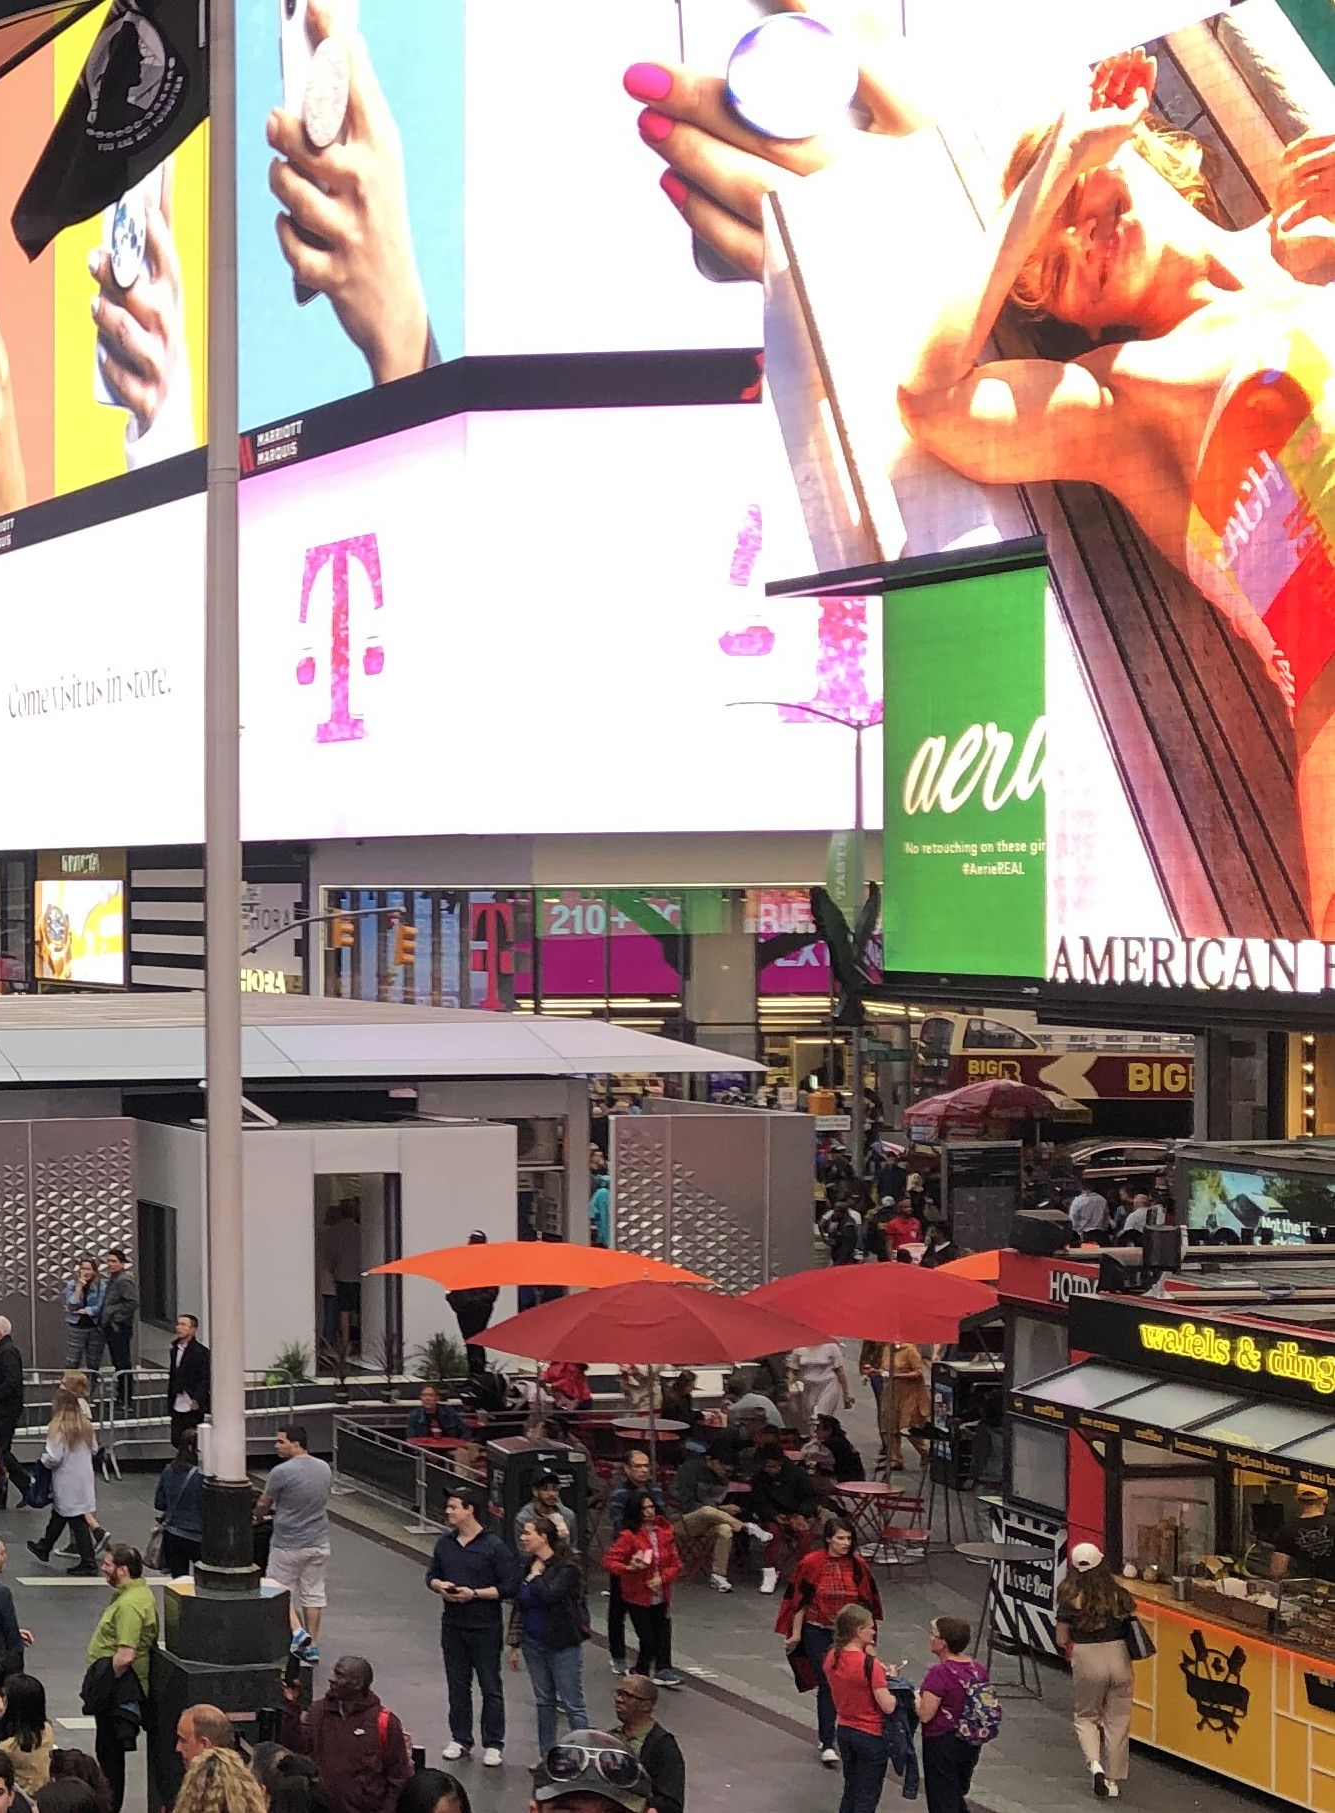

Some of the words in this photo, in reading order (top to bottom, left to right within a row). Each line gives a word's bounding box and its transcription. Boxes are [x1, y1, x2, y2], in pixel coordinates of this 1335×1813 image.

[256, 419, 304, 448] MARRIOTT
[256, 441, 298, 466] MARQUIS
[8, 683, 49, 718] Come
[922, 840, 978, 856] retouching
[981, 842, 994, 853] on
[996, 839, 1027, 853] these
[1049, 934, 1304, 992] AMERICAN
[967, 1059, 998, 1075] BIG
[1127, 1062, 1187, 1093] BIG
[1139, 1321, 1231, 1366] wafels
[1236, 1336, 1262, 1372] &
